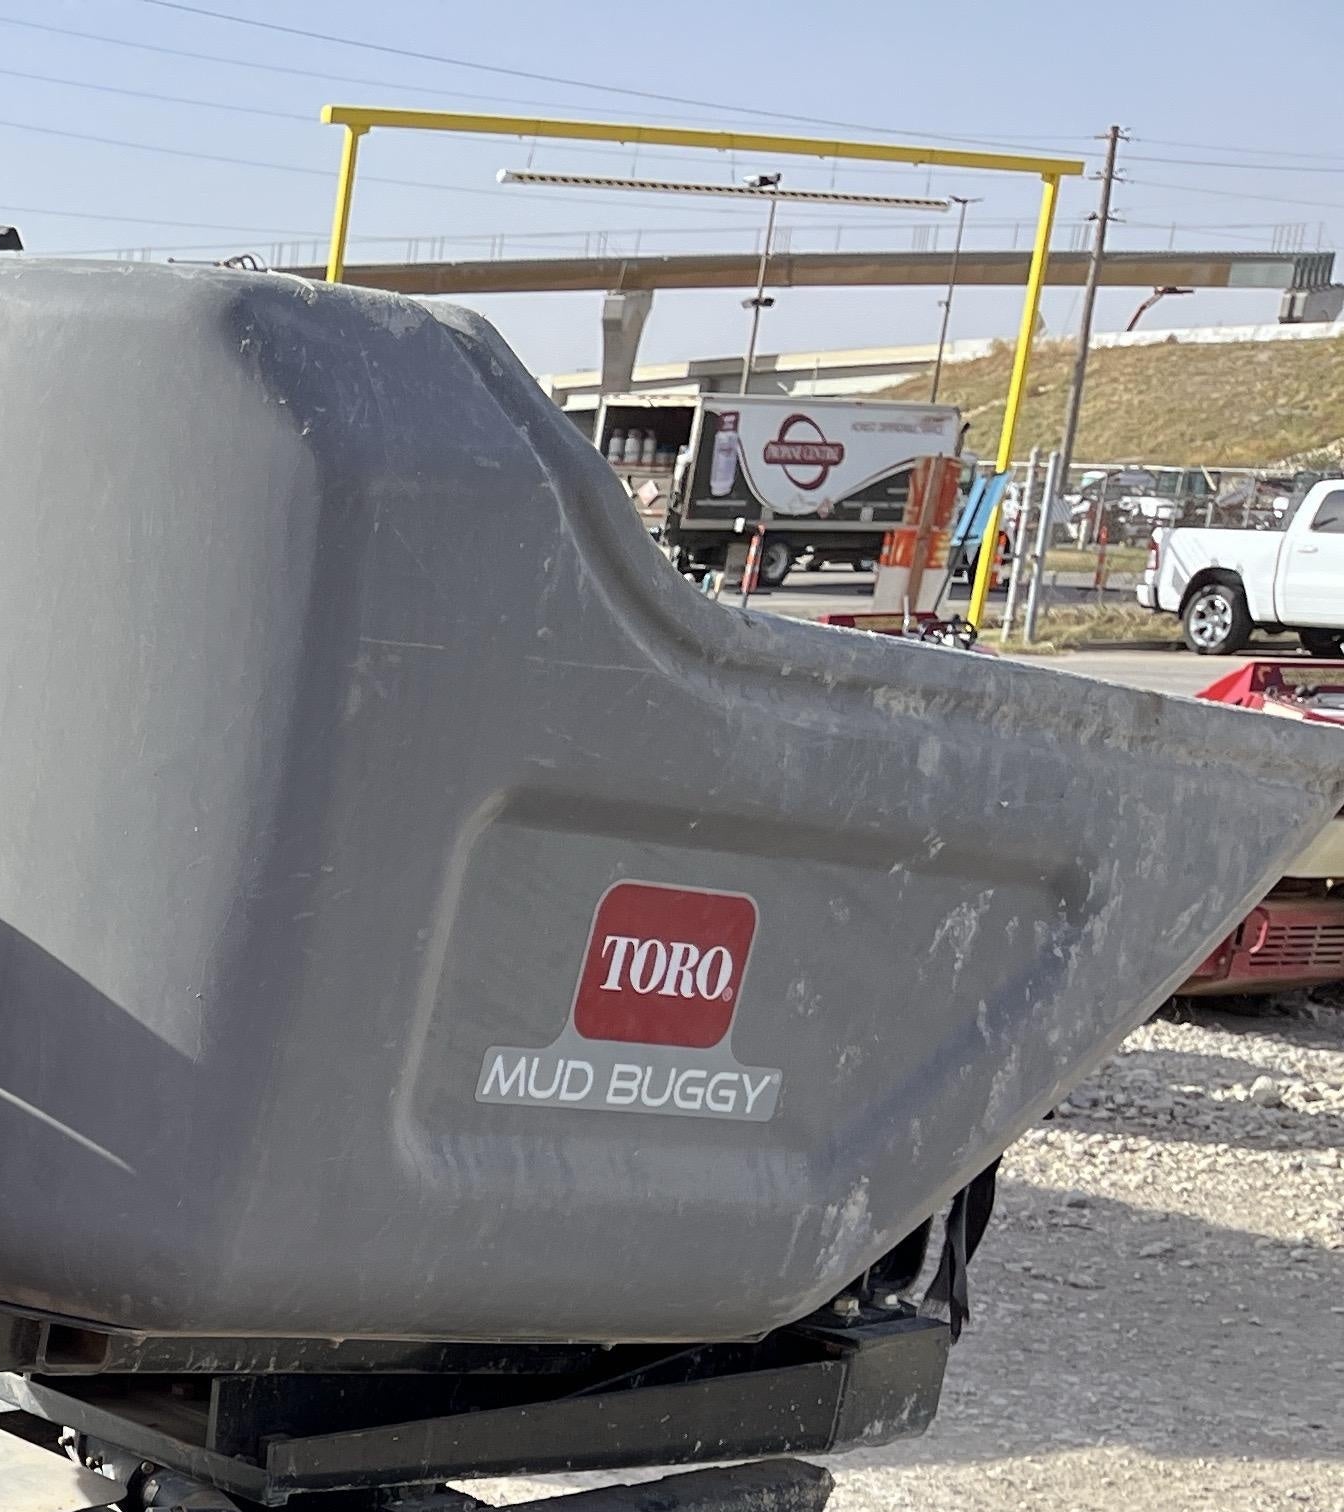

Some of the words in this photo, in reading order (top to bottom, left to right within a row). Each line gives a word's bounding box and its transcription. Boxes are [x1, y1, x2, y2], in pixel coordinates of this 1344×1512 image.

[599, 934, 734, 1002] TORO
[481, 1053, 595, 1103] MUD
[605, 1062, 772, 1115] BUGGY
